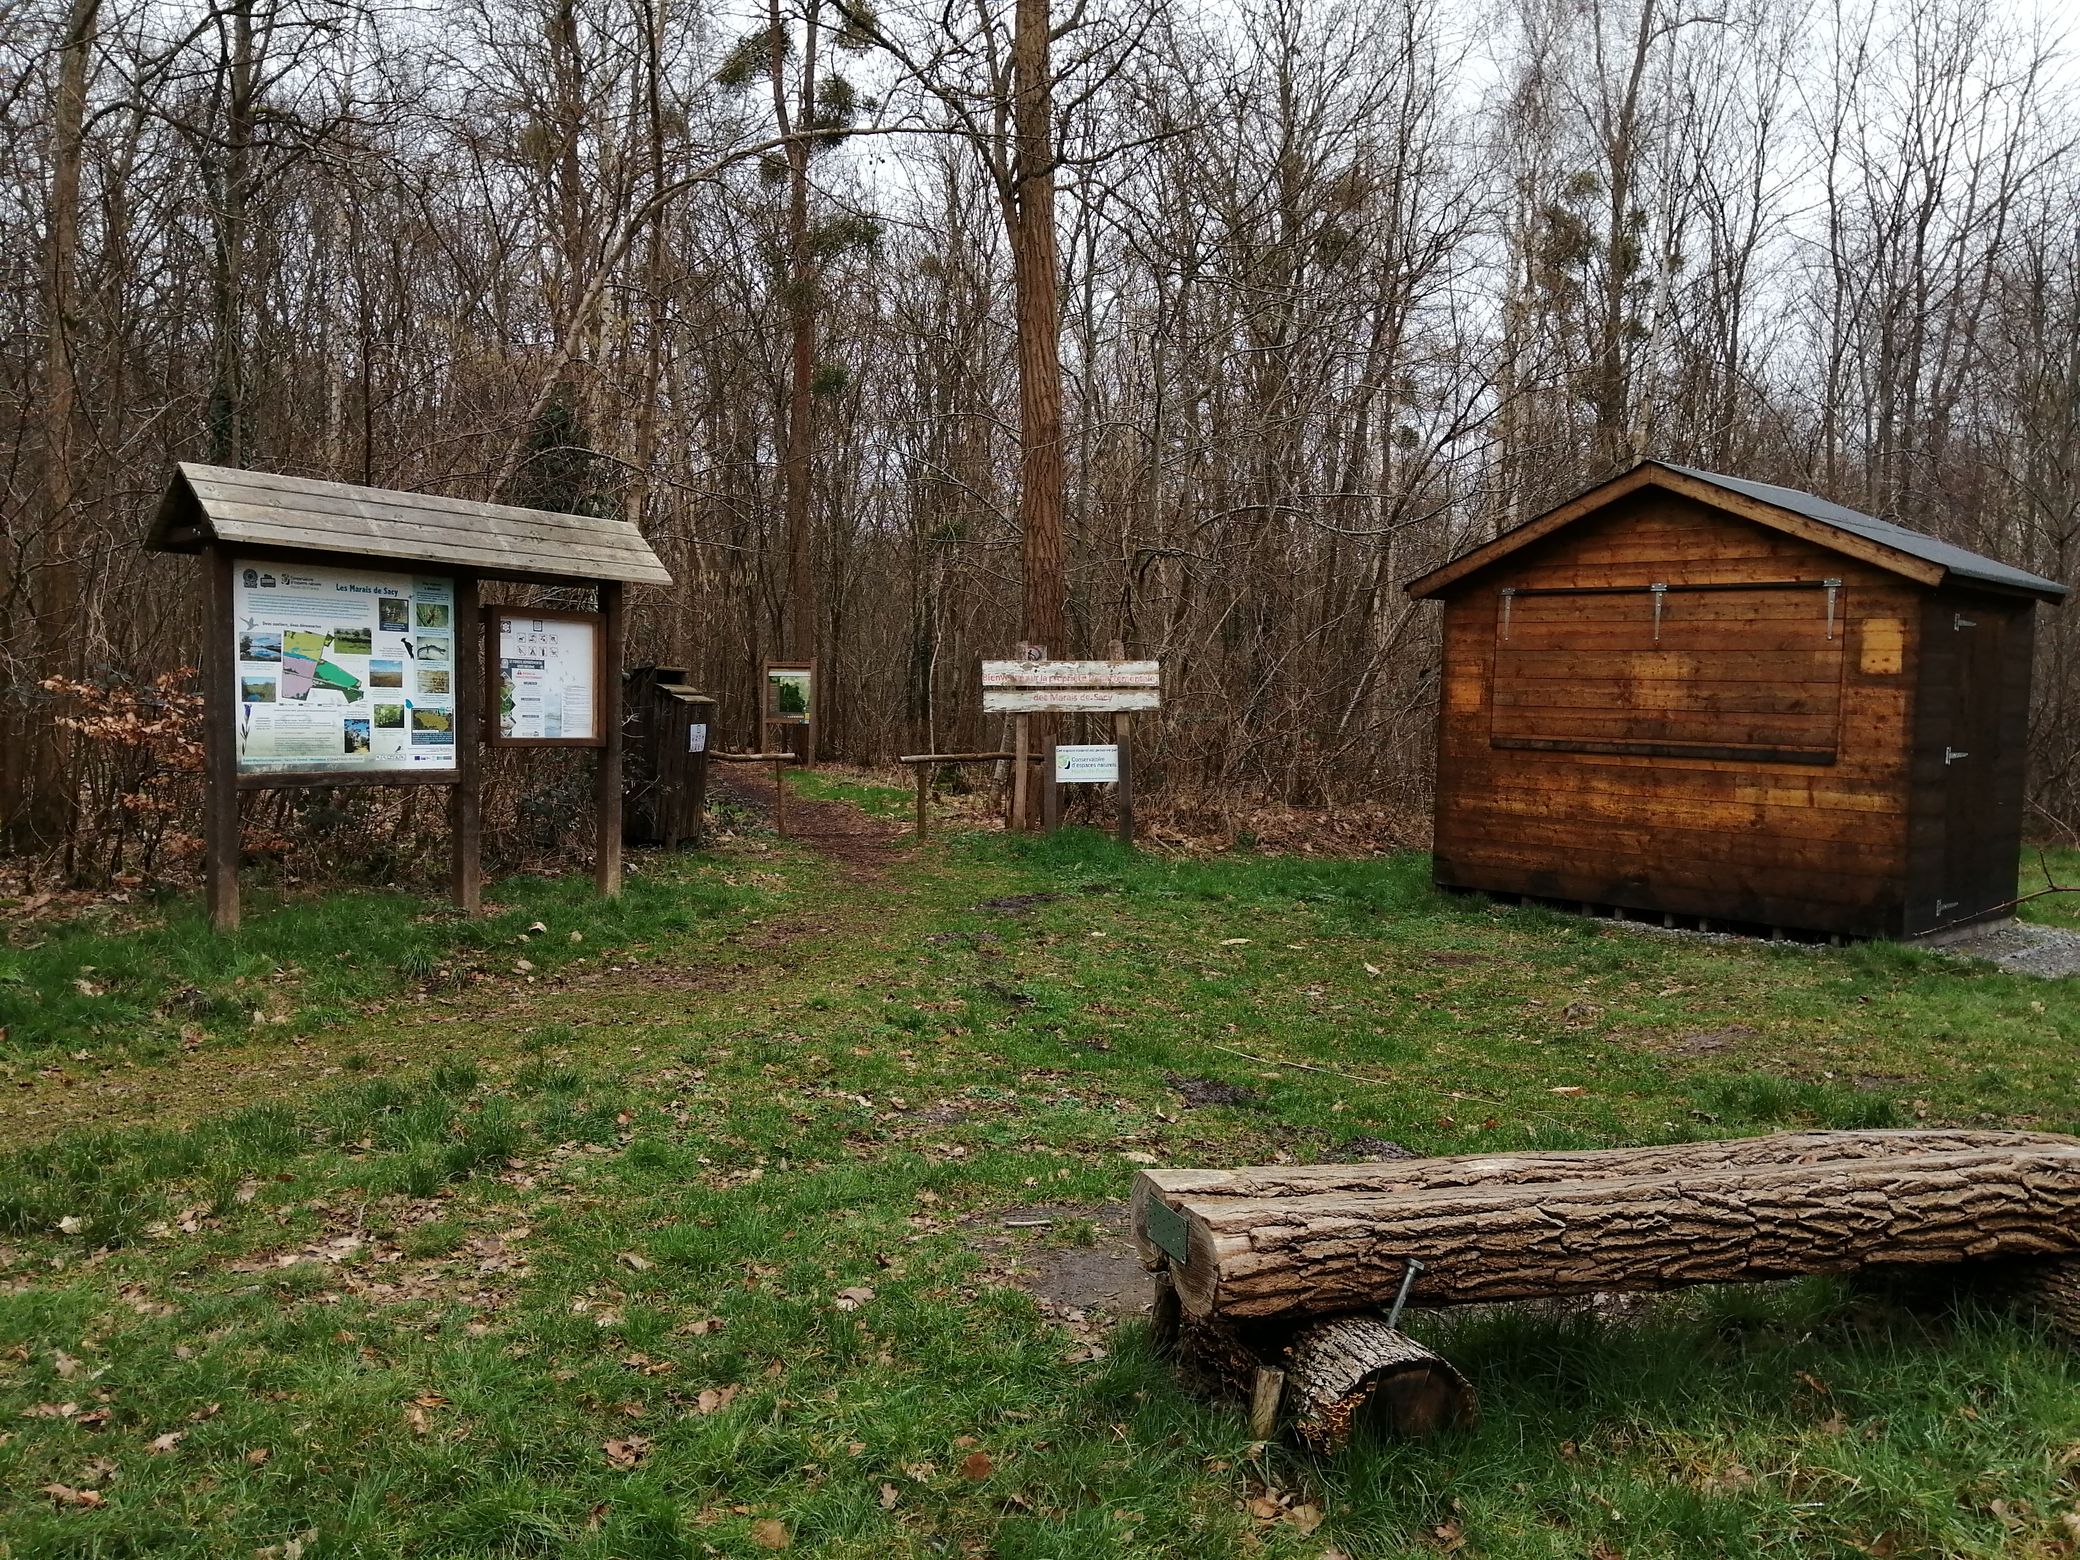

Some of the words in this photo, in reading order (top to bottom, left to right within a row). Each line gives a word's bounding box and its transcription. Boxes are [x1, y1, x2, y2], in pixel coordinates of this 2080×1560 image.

[336, 583, 348, 592] Les
[349, 584, 372, 593] Marais
[373, 586, 382, 594] de
[383, 587, 399, 597] Sacy
[1033, 693, 1048, 702] des
[1050, 693, 1078, 702] Marais
[1080, 693, 1091, 702] de
[1093, 693, 1113, 703] Sacy
